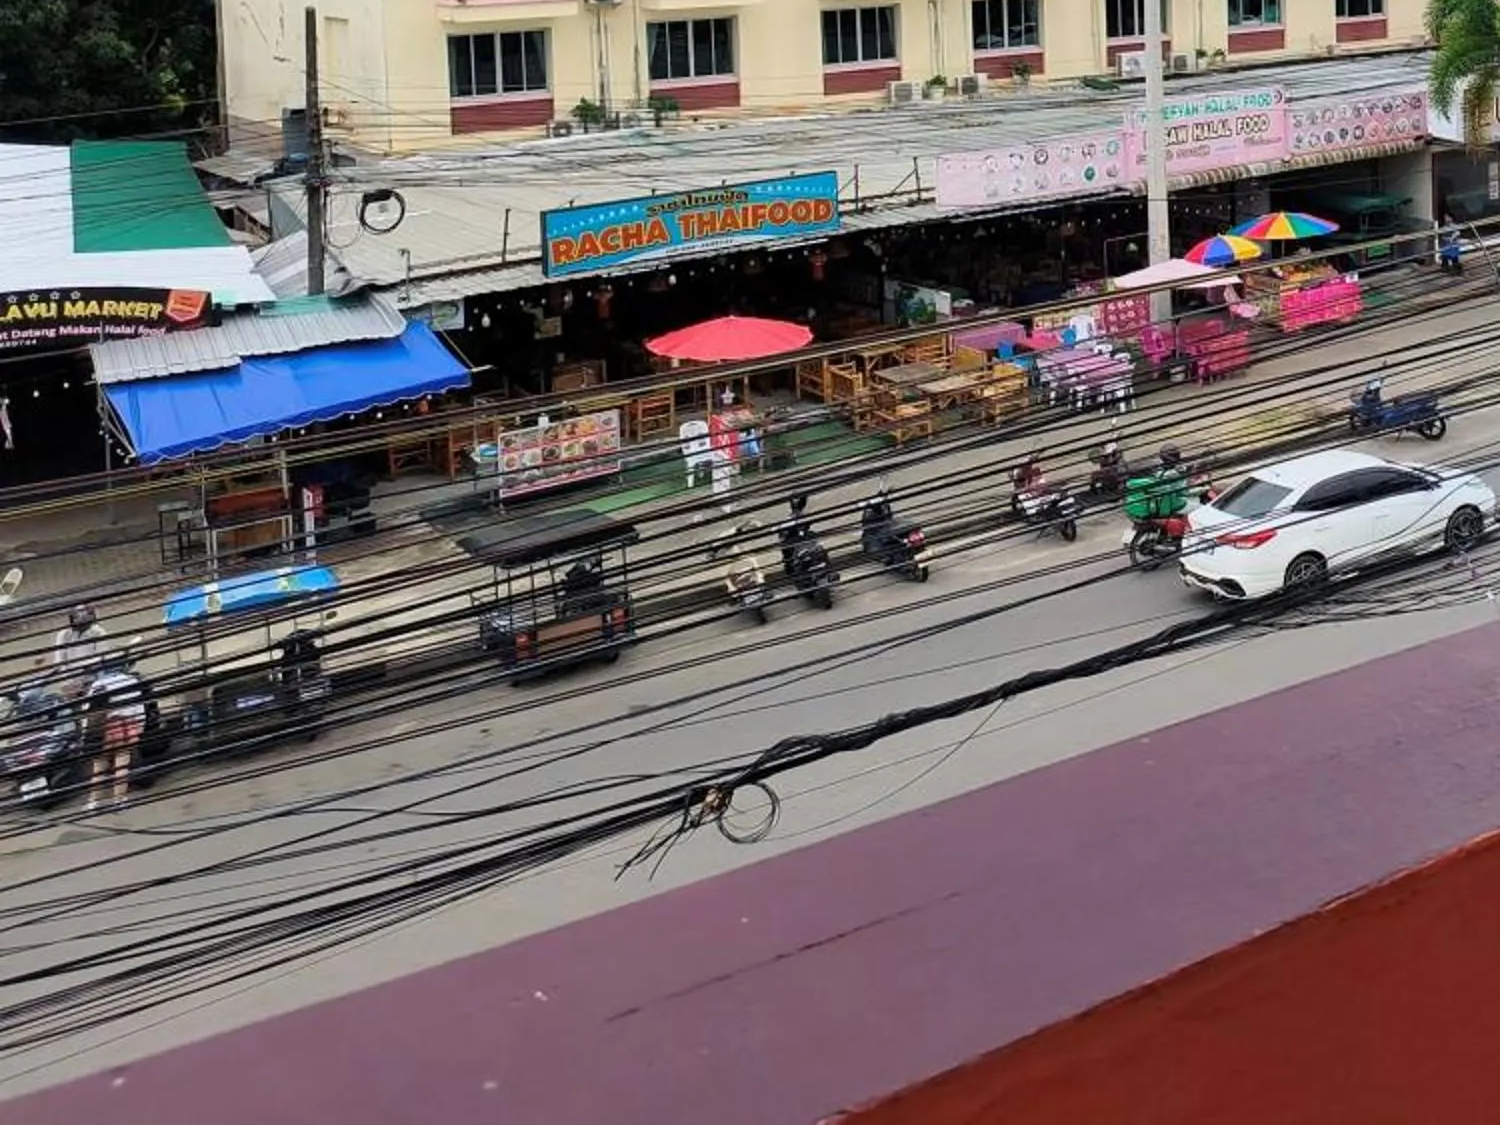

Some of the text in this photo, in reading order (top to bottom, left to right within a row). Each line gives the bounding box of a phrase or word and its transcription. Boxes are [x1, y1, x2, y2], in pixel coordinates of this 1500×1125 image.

[1191, 118, 1233, 141] HALAL
[1235, 113, 1271, 136] FOOD
[551, 199, 833, 266] RACHA THAIFOOD
[63, 300, 163, 320] MARKET
[11, 327, 57, 340] Datang
[59, 324, 101, 336] Makan
[104, 324, 136, 336] Halal
